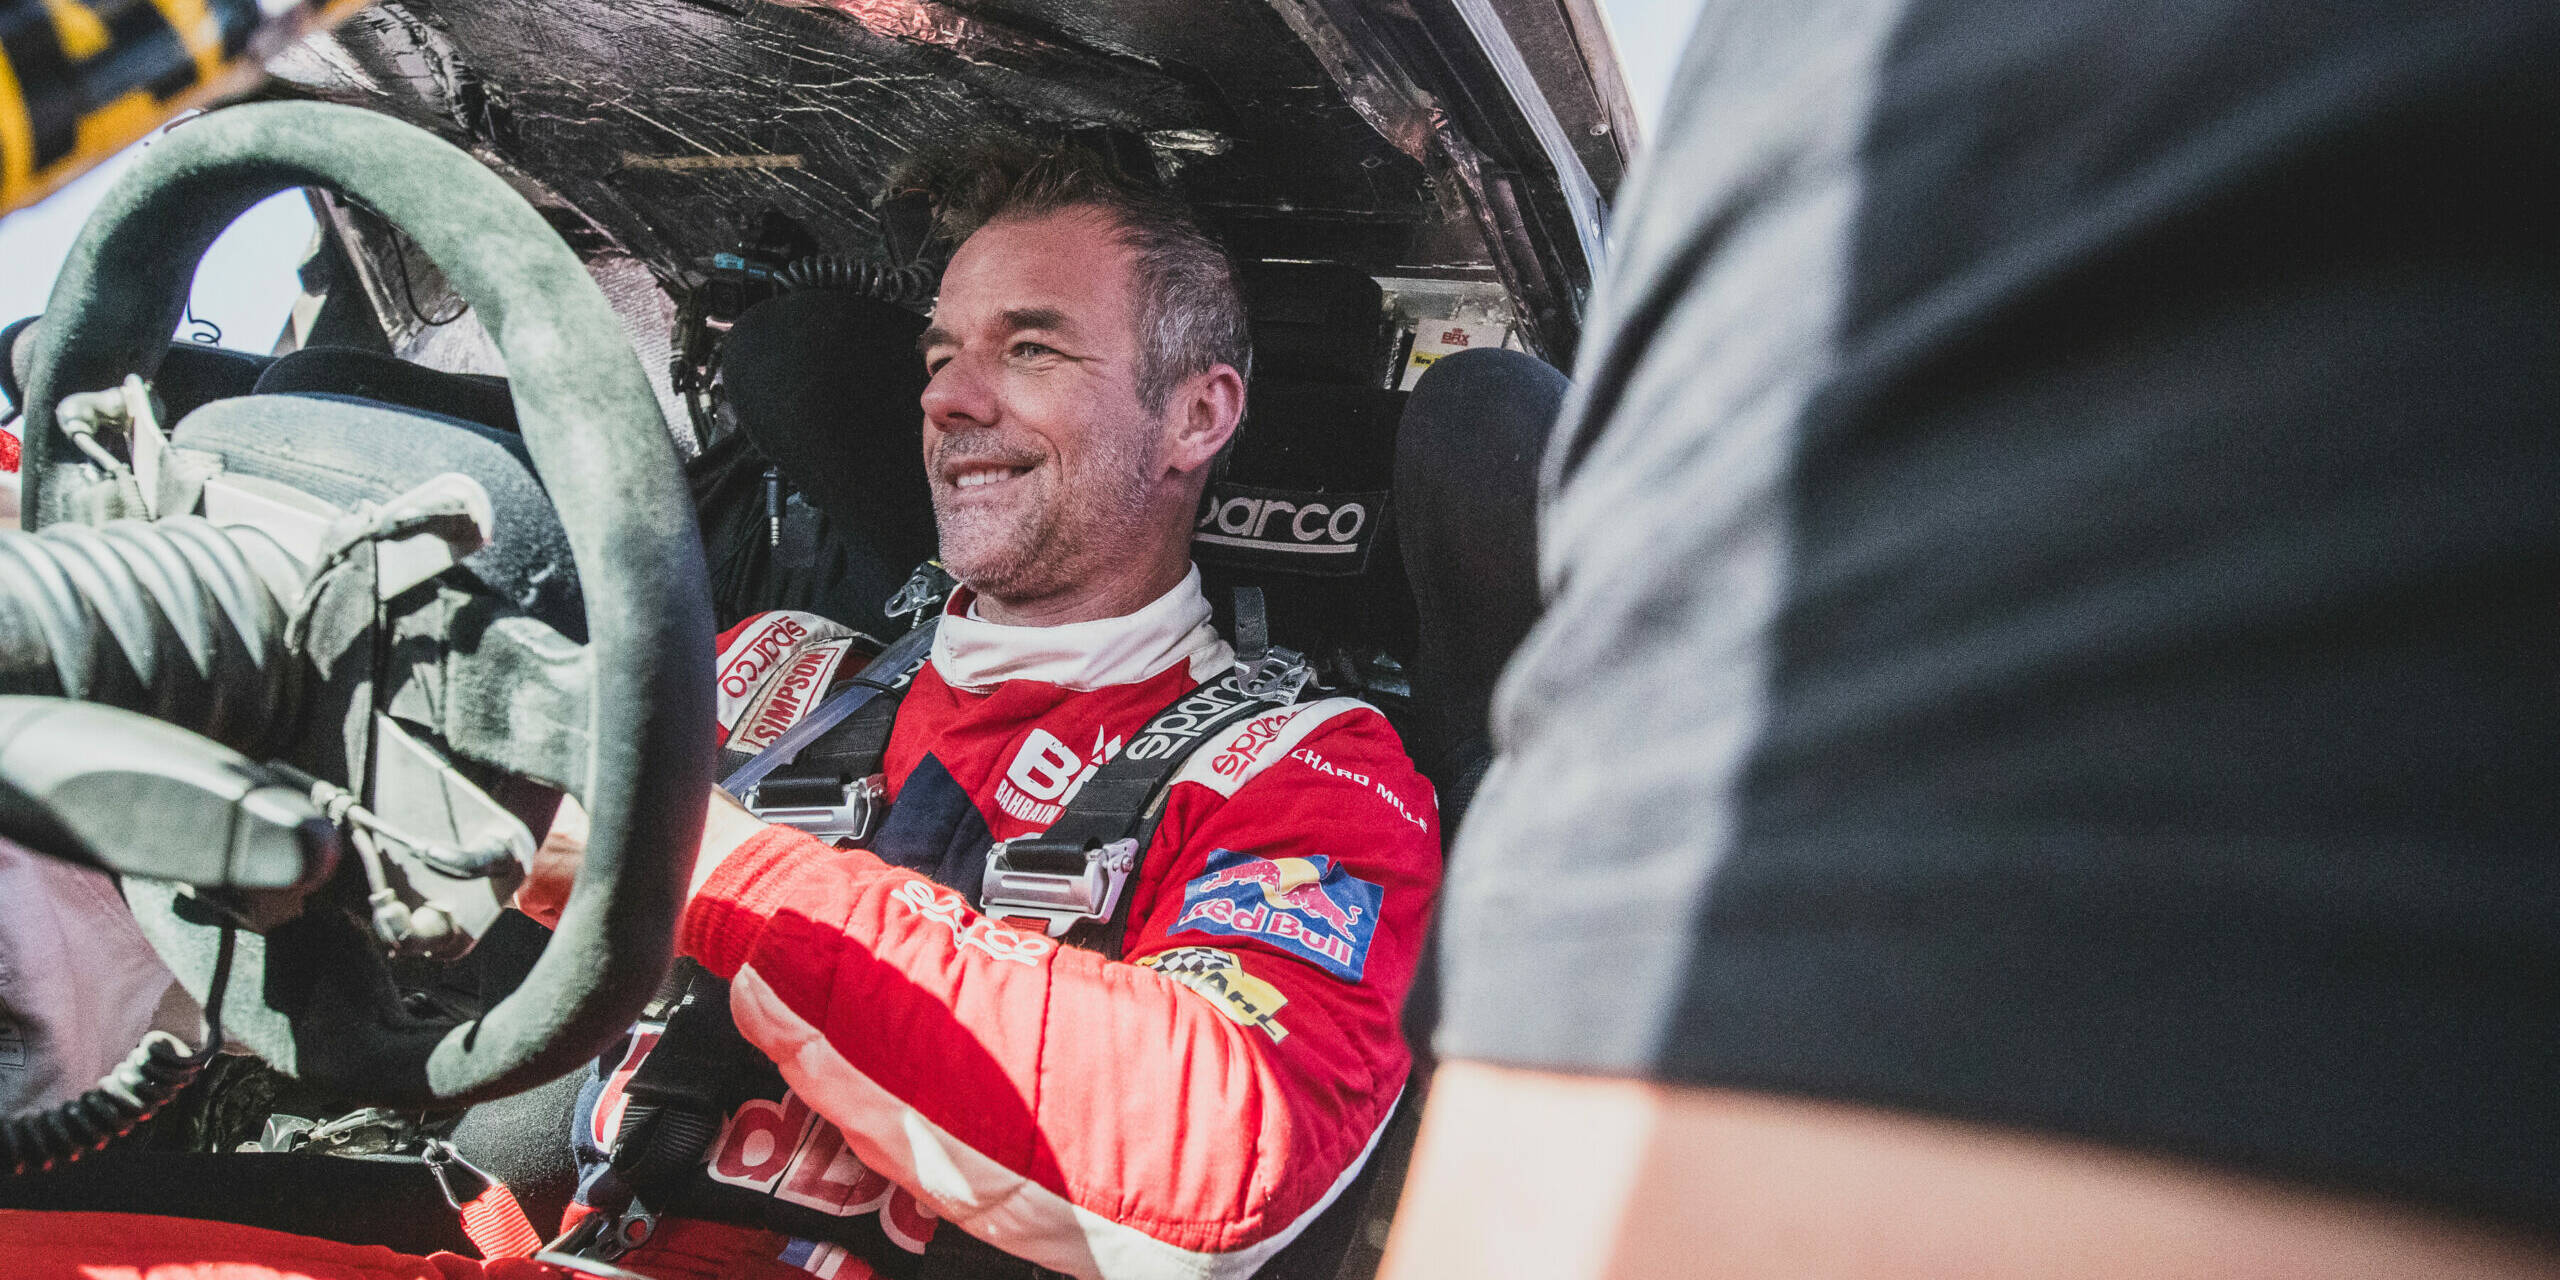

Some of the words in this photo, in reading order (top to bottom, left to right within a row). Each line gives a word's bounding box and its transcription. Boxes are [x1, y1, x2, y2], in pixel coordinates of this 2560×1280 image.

[722, 620, 808, 698] sparco
[754, 652, 828, 744] SIMPSON
[994, 778, 1062, 825] BAHRAIN
[1376, 782, 1428, 834] MILLE
[1266, 911, 1353, 967] Bull
